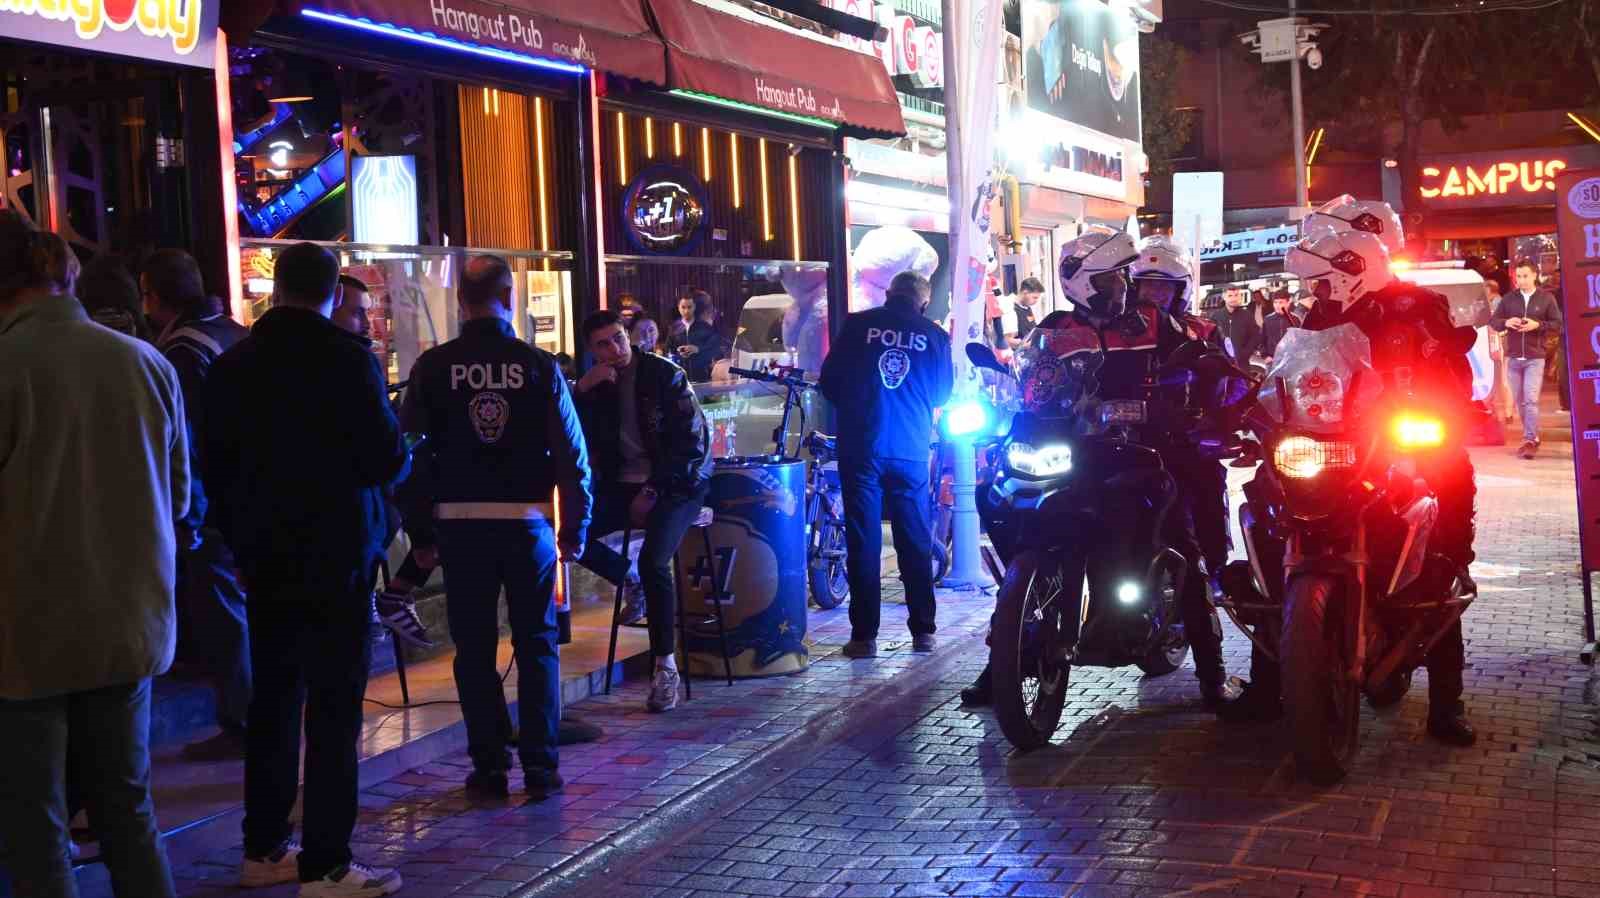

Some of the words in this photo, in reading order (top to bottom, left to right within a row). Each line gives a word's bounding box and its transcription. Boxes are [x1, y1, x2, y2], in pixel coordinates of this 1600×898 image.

[431, 0, 506, 40] Hangout
[509, 15, 543, 49] Pub
[755, 78, 797, 108] Hangout
[797, 87, 816, 112] Pub
[1420, 159, 1566, 198] CAMPUS
[648, 196, 674, 224] +1
